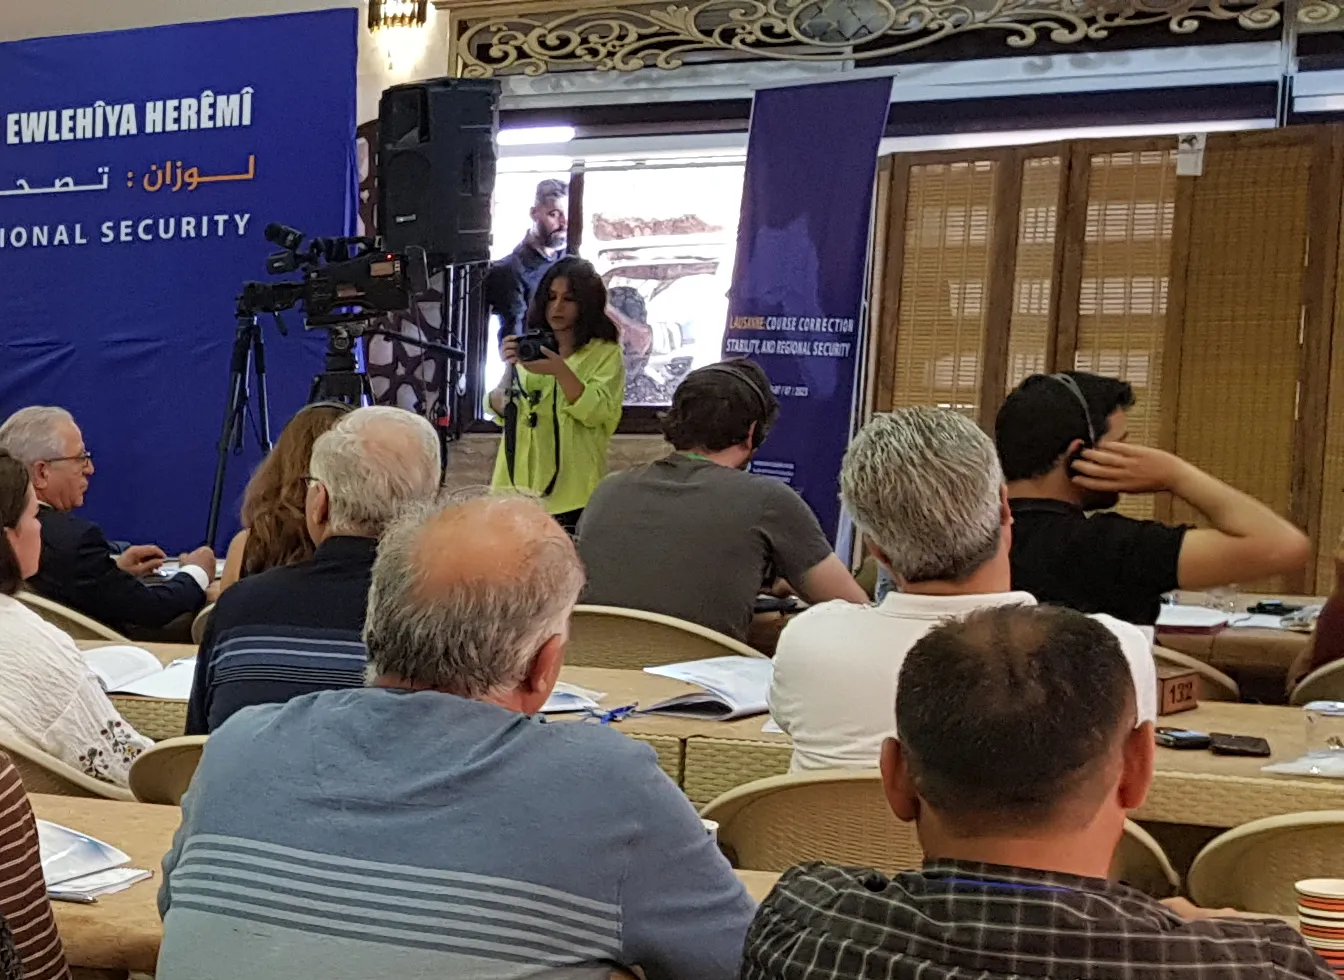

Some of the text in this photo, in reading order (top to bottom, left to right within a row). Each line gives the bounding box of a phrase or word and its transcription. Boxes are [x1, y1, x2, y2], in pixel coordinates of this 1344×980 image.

[6, 100, 138, 145] EWLEHÎYA
[145, 86, 255, 134] HERÊMÎ
[101, 213, 251, 244] SECURITY
[766, 316, 797, 331] COURSE
[798, 318, 854, 333] CORRECTION
[813, 342, 851, 357] SECURITY
